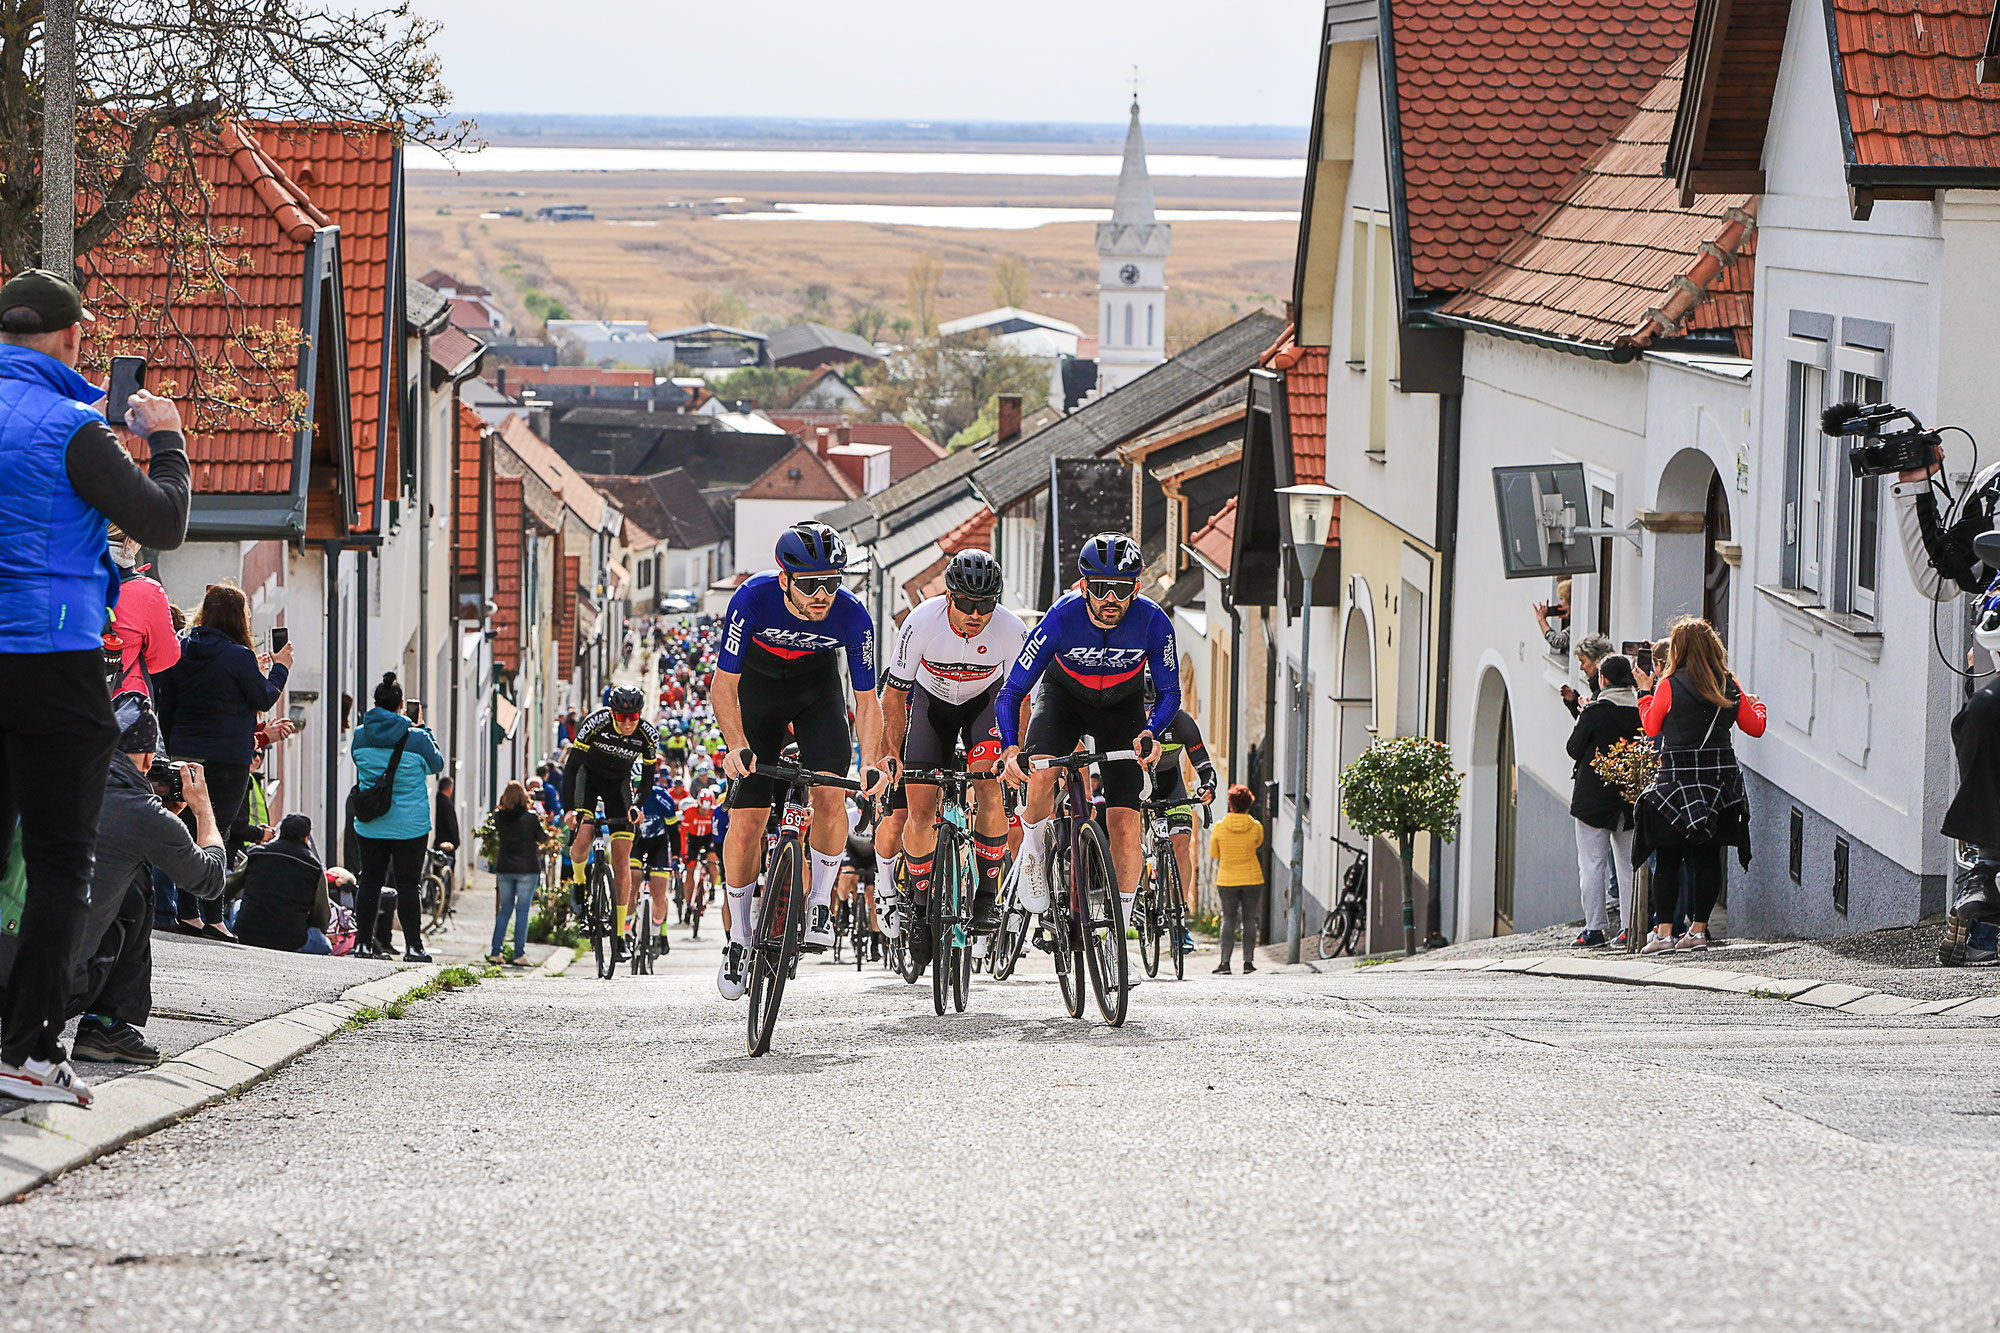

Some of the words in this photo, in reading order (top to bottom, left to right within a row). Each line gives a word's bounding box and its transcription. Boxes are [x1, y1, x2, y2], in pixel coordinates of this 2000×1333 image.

[725, 609, 745, 656] BMC
[1018, 627, 1048, 671] BMC
[577, 711, 610, 741] KIRCHMAIR
[54, 1069, 71, 1088] N
